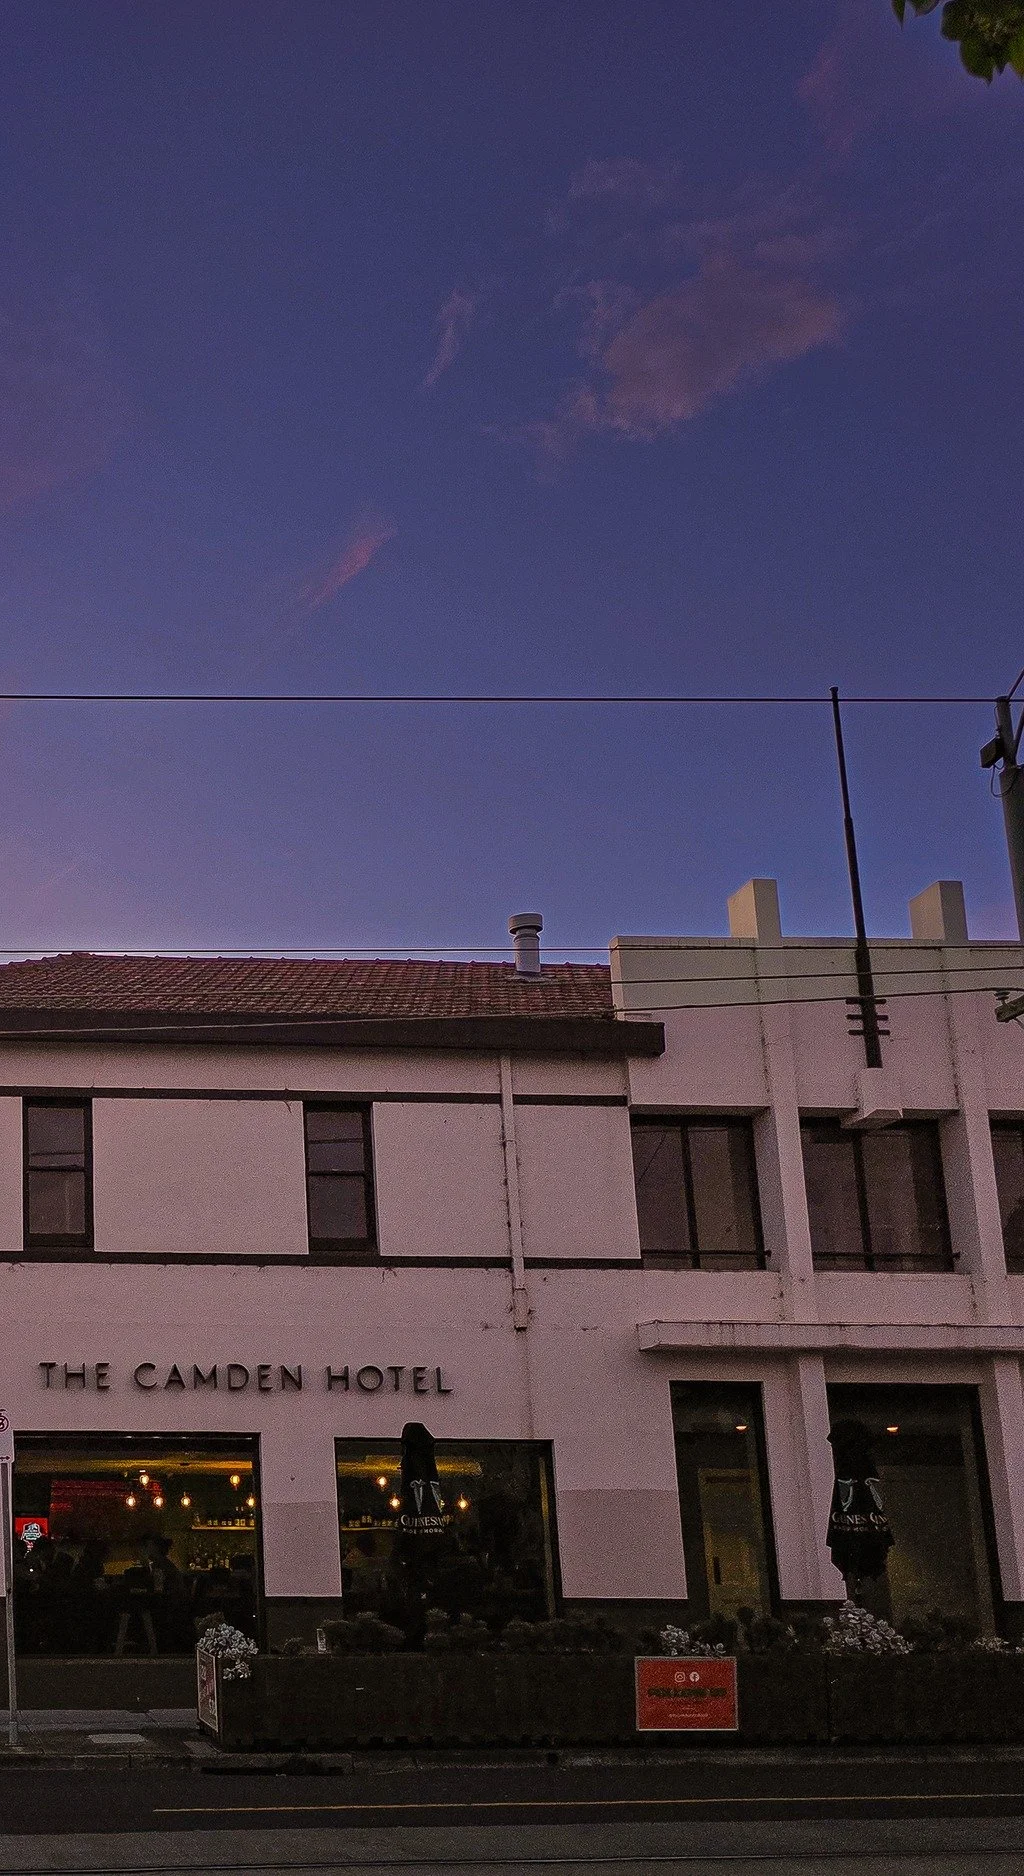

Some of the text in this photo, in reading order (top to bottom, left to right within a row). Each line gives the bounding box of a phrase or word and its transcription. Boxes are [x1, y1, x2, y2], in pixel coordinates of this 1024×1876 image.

[39, 1362, 454, 1394] THE CAMDEN HOTEL
